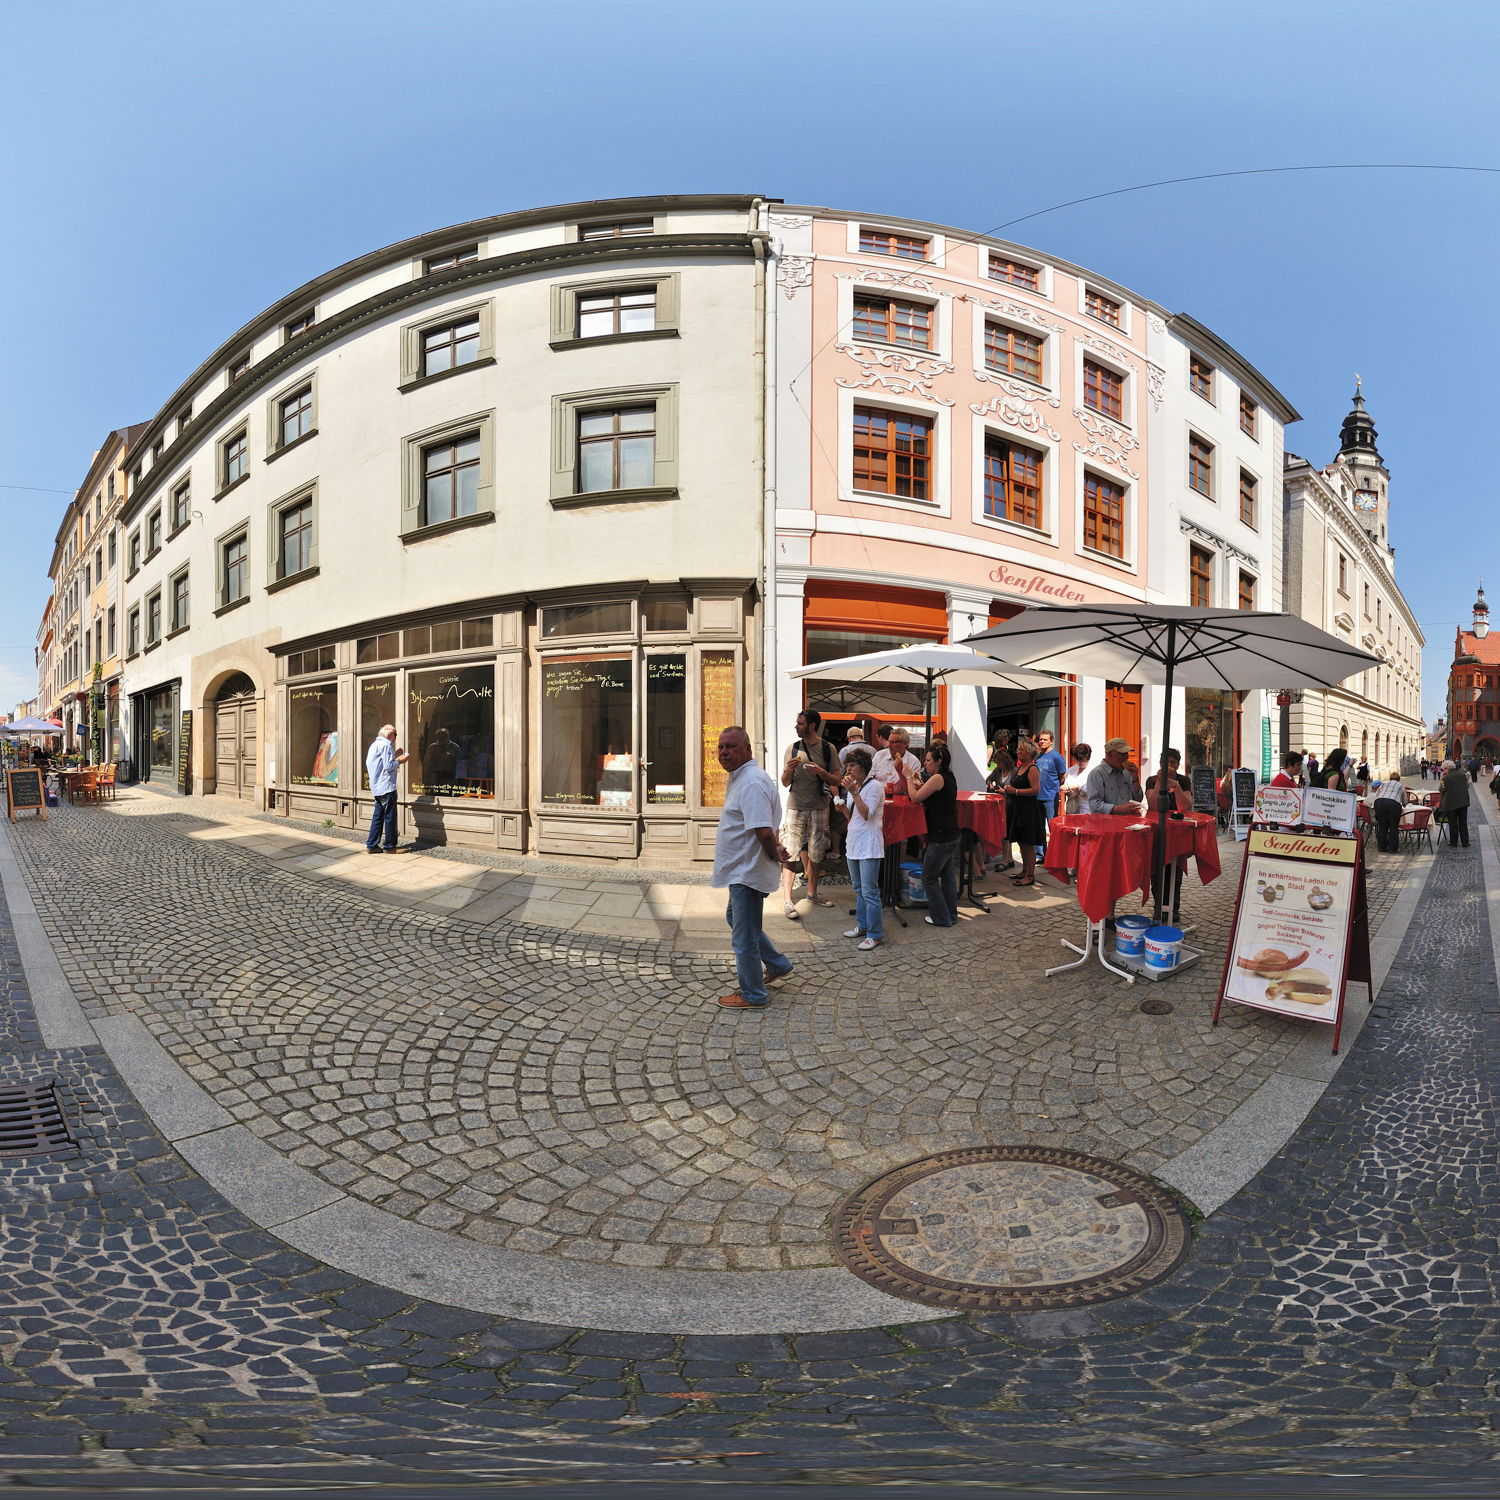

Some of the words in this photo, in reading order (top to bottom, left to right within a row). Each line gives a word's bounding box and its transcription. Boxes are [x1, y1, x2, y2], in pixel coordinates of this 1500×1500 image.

[989, 566, 1086, 602] Senfladen
[439, 675, 460, 684] Galerie
[1311, 792, 1347, 804] Fleischkäse
[1263, 835, 1341, 856] Senfladen
[1268, 872, 1303, 883] schärfsten
[1304, 876, 1325, 885] Laden
[1287, 882, 1306, 891] Stadt
[1301, 915, 1324, 923] Getränke
[1257, 923, 1277, 931] Original
[1277, 923, 1300, 934] Thüringer
[1301, 927, 1325, 941] Bratwurst
[1276, 931, 1303, 940] Bockwurst
